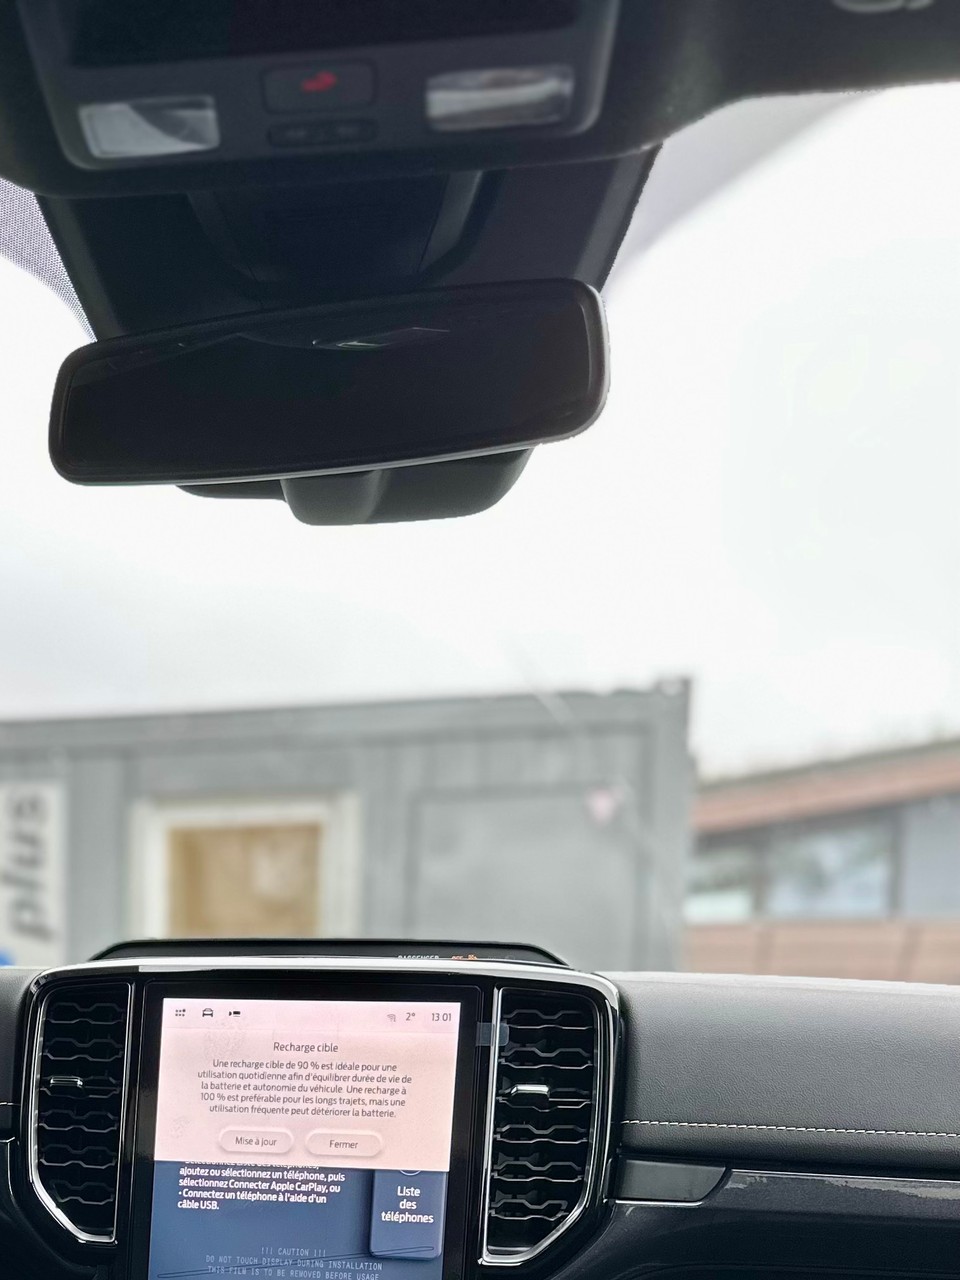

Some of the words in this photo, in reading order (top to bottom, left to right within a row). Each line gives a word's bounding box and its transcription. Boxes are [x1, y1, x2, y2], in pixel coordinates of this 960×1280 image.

[406, 1012, 416, 1021] 2°
[273, 1041, 315, 1053] Recharge
[317, 1043, 339, 1053] cible
[213, 1059, 229, 1068] Une
[230, 1060, 264, 1070] recharge
[265, 1060, 284, 1069] cible
[285, 1061, 296, 1069] de
[297, 1061, 309, 1070] 90
[310, 1061, 320, 1070] %
[321, 1062, 333, 1070] est
[335, 1061, 360, 1071] idéale
[361, 1063, 380, 1073] pour
[381, 1064, 397, 1072] une
[198, 1070, 237, 1079] utilisation
[238, 1071, 287, 1081] quotidienne
[288, 1072, 303, 1081] afin
[305, 1073, 351, 1082] d'équilibrer
[351, 1073, 375, 1083] durée
[376, 1074, 387, 1083] de
[388, 1075, 400, 1084] vie
[401, 1076, 412, 1084] de
[201, 1081, 208, 1090] la
[210, 1081, 241, 1091] batterie
[243, 1083, 251, 1091] et
[252, 1083, 296, 1092] autonomie
[297, 1084, 308, 1093] du
[346, 1085, 363, 1094] Une
[364, 1086, 400, 1096] recharge
[401, 1086, 407, 1095] à
[200, 1092, 215, 1101] 100
[217, 1093, 226, 1101] %
[227, 1094, 239, 1102] est
[240, 1093, 281, 1103] préférable
[282, 1095, 301, 1104] pour
[302, 1095, 314, 1104] les
[315, 1096, 337, 1106] longs
[339, 1096, 367, 1107] trajets,
[369, 1097, 389, 1106] mais
[390, 1098, 406, 1107] une
[209, 1104, 249, 1113] utilisation
[250, 1105, 290, 1115] fréquente
[290, 1106, 309, 1116] peut
[311, 1107, 351, 1116] détériorer
[352, 1108, 360, 1117] la
[361, 1108, 396, 1118] batterie.
[235, 1136, 254, 1146] Mise
[254, 1137, 260, 1146] à
[261, 1137, 277, 1147] jour
[329, 1139, 358, 1149] Fermer
[179, 1167, 209, 1176] ajoutez
[221, 1167, 271, 1178] sélectionnez
[272, 1171, 282, 1179] un
[283, 1170, 327, 1181] téléphone,
[328, 1172, 346, 1182] puis
[179, 1177, 228, 1188] sélectionnez
[229, 1179, 270, 1190] Connecter
[270, 1181, 294, 1192] Apple
[295, 1182, 329, 1193] CarPlay,
[329, 1185, 341, 1193] ou
[397, 1185, 421, 1197] Liste
[182, 1188, 224, 1199] Connectez
[225, 1192, 236, 1200] un
[236, 1191, 277, 1202] téléphone
[278, 1192, 284, 1200] à
[284, 1192, 307, 1203] l'aide
[308, 1193, 327, 1204] d'un
[177, 1199, 200, 1209] câble
[200, 1200, 220, 1210] USB.
[399, 1198, 417, 1210] des
[381, 1210, 434, 1224] téléphones
[277, 1247, 310, 1257] CAUTION
[205, 1254, 215, 1263] DO
[218, 1255, 232, 1264] NOT
[236, 1256, 258, 1265] TOUCH
[262, 1257, 293, 1266] DISPLAY
[297, 1259, 324, 1268] DURING
[328, 1260, 383, 1271] INSTALLATION
[251, 1267, 260, 1276] IS
[264, 1268, 273, 1276] TO
[276, 1268, 286, 1277] BE
[289, 1269, 321, 1279] REMOVED
[325, 1271, 352, 1280] BEFORE
